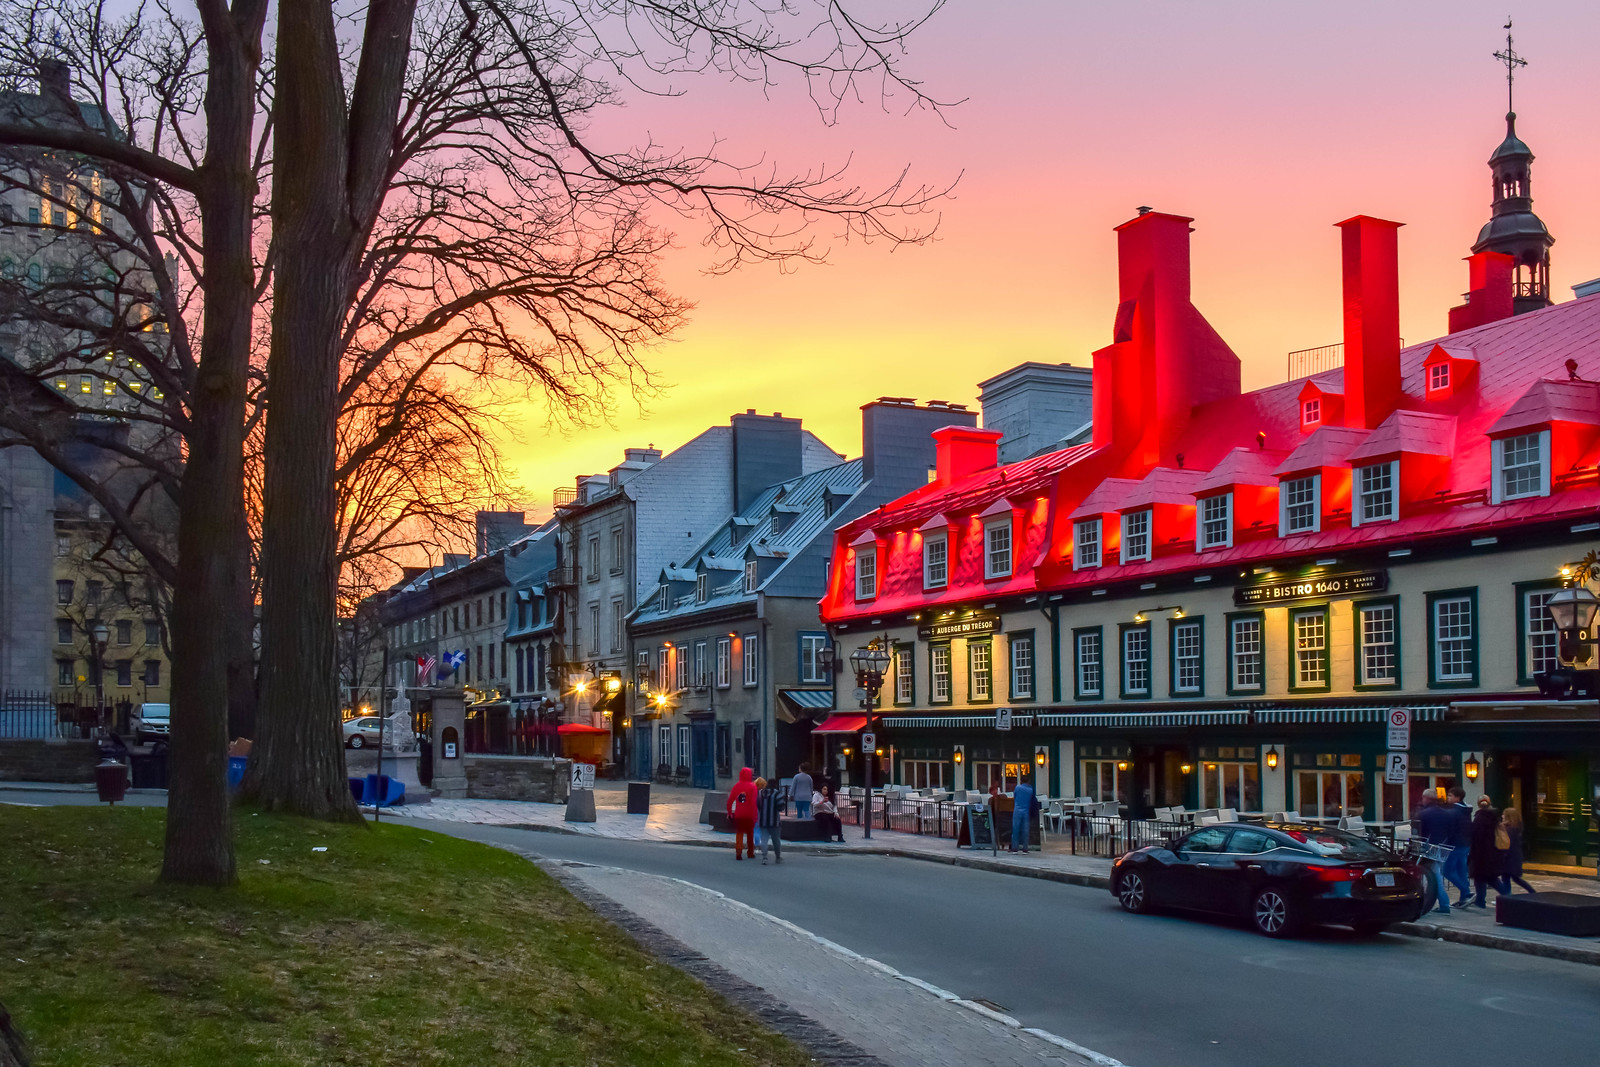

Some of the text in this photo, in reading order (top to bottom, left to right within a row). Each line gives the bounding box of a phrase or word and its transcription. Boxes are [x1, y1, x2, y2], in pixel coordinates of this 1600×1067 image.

[1274, 581, 1340, 598] BISTRO 1640
[936, 624, 961, 635] AUBERGE
[962, 623, 970, 632] DU
[971, 620, 993, 630] TRÉSOR
[1000, 709, 1008, 719] P
[1393, 755, 1402, 769] P
